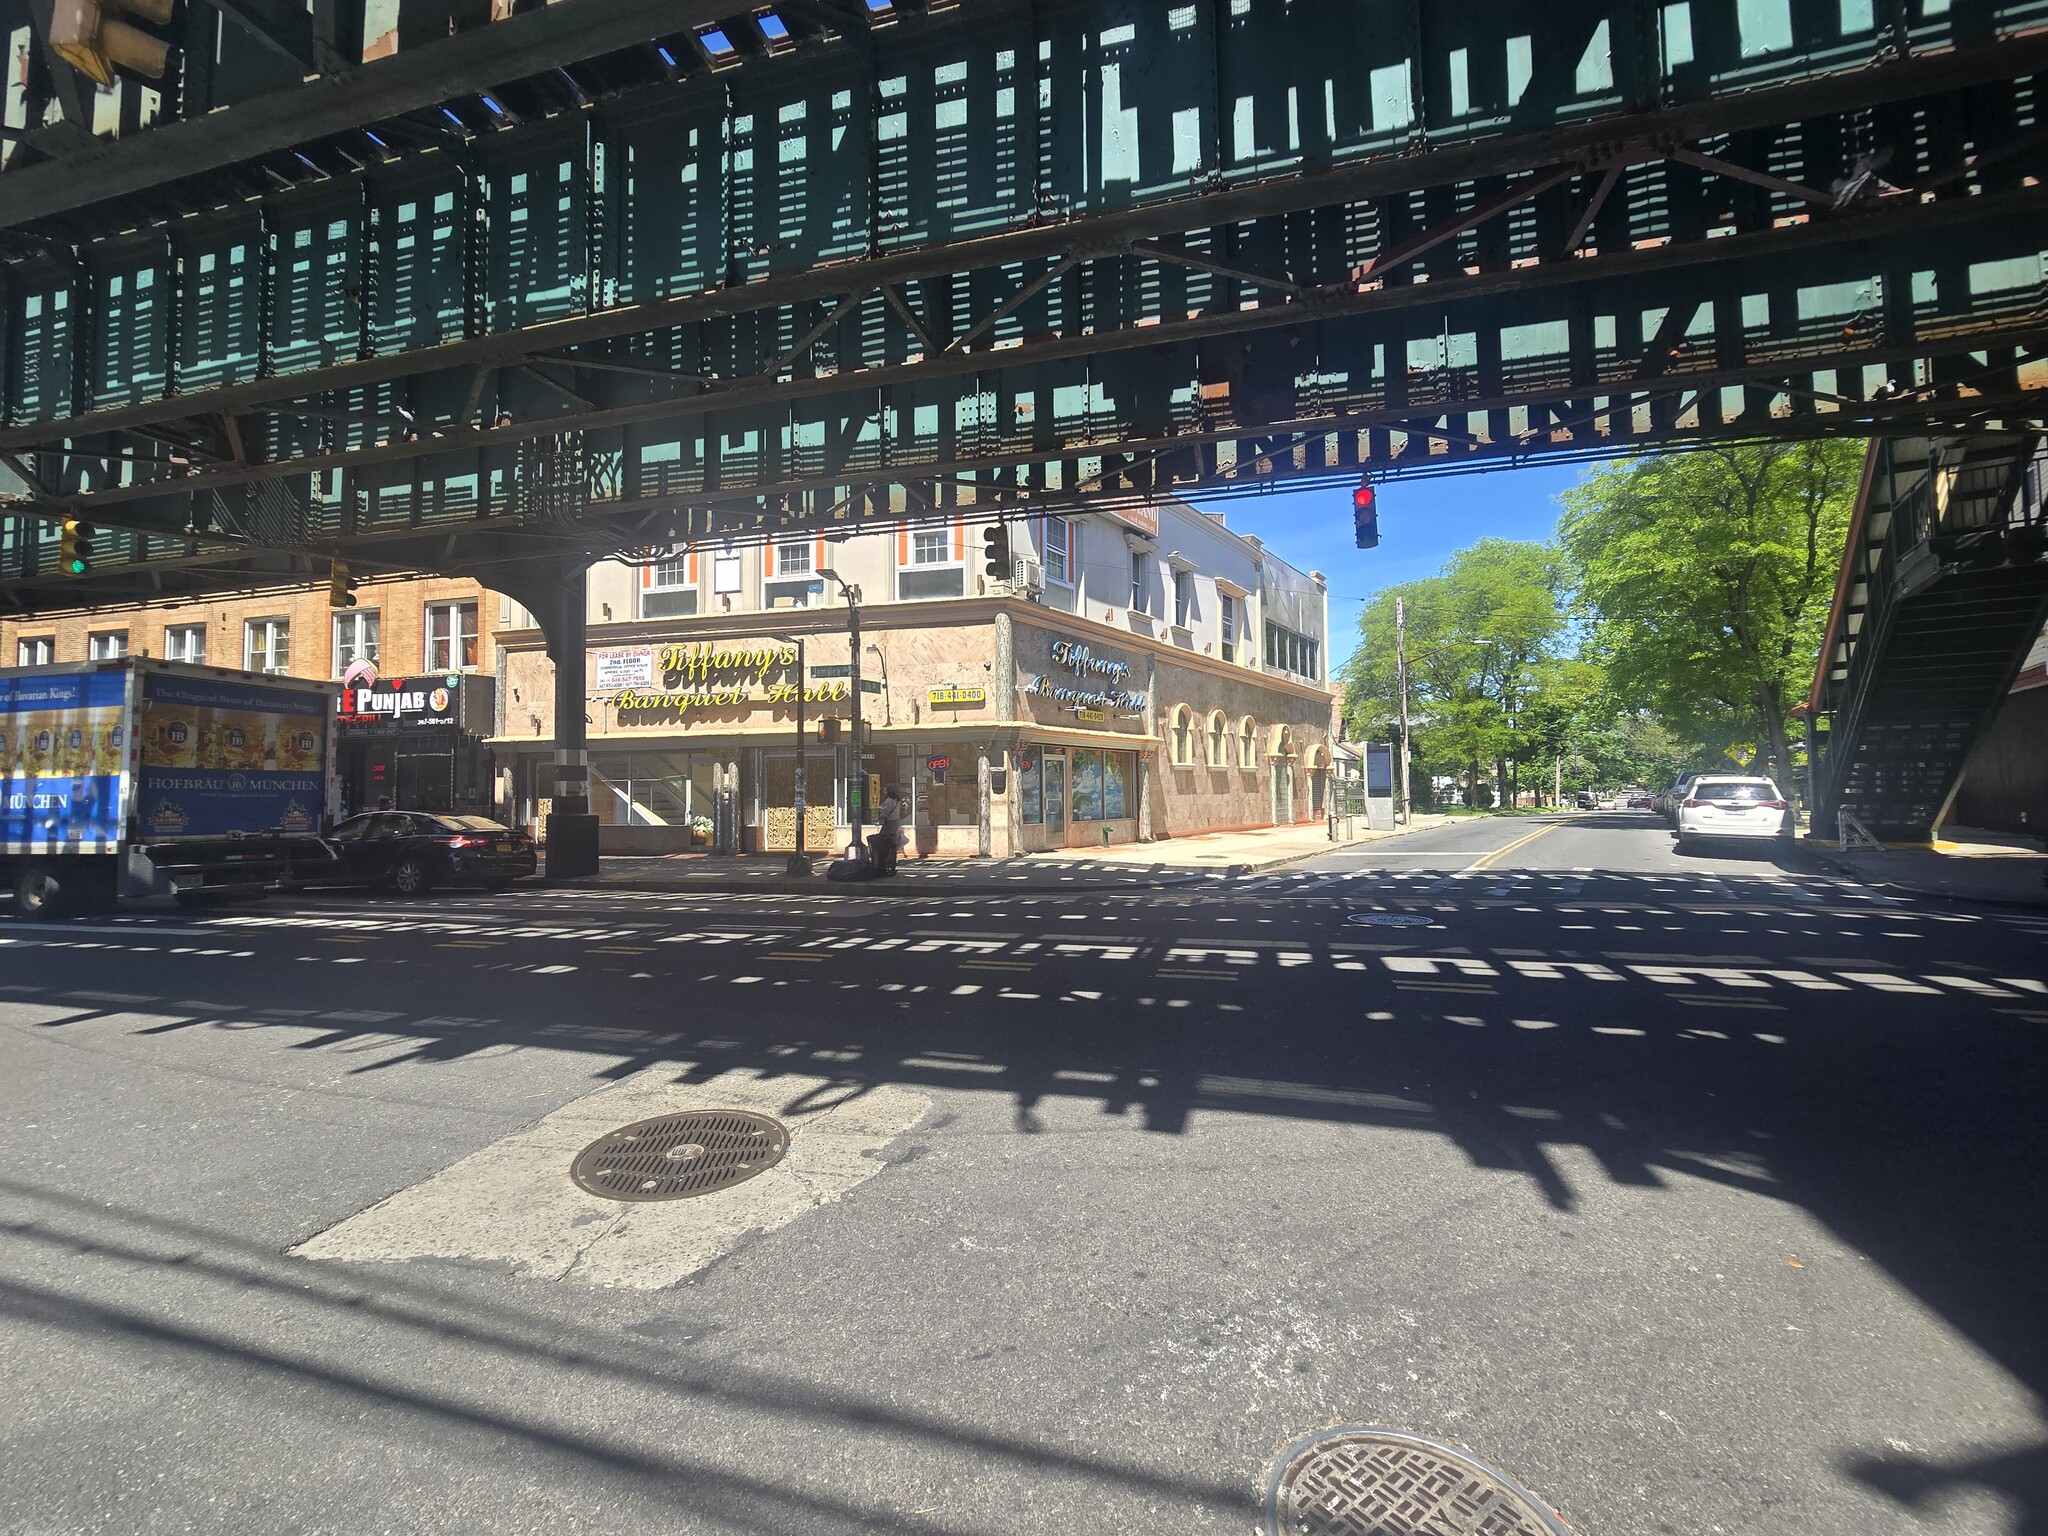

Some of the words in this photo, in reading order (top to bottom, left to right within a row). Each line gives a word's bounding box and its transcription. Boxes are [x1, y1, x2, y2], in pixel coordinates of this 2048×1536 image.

[657, 641, 796, 681] Tiffany's
[1051, 640, 1132, 685] Tiffany's
[811, 667, 841, 678] Jamaica
[14, 690, 48, 702] Bavarian
[49, 686, 77, 702] Kings!
[611, 688, 750, 715] Banquet
[766, 680, 850, 704] Hall
[1031, 674, 1108, 708] Banquet
[928, 759, 950, 771] OPEN
[149, 776, 224, 791] HOFBRÄU
[250, 778, 319, 791] MÜNCHEN
[4, 792, 67, 809] MÜNCHEN
